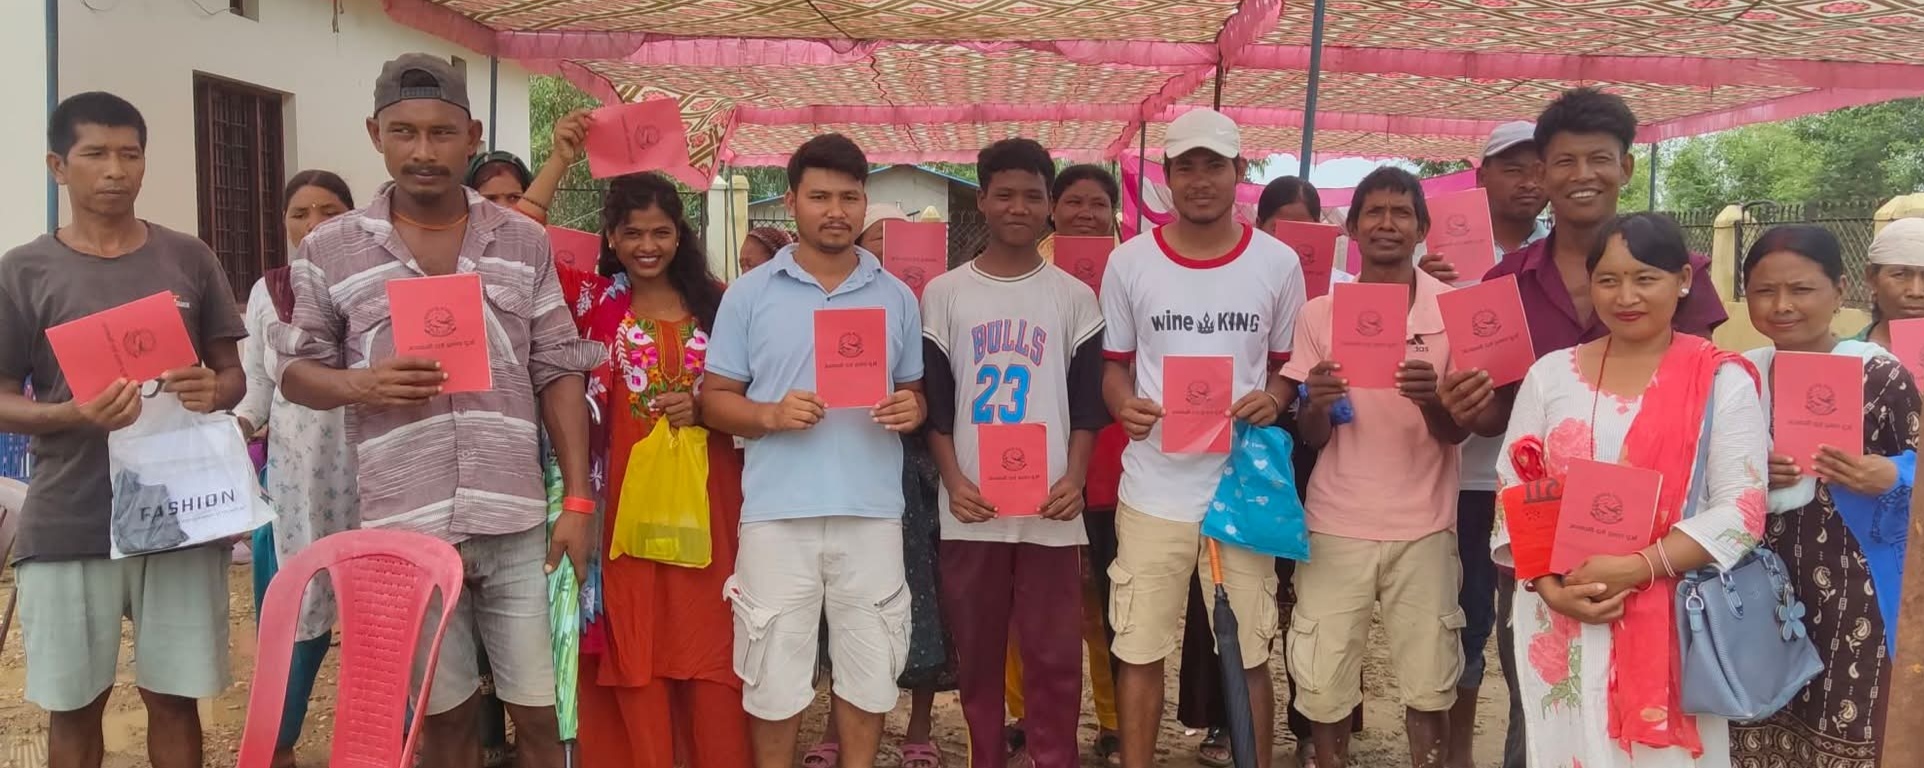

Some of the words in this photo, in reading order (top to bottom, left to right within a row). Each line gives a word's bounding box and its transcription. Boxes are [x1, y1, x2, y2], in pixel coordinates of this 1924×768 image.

[1151, 309, 1194, 332] wine
[1217, 311, 1260, 333] KING
[971, 318, 1047, 367] BULLS
[971, 363, 1031, 424] 23
[140, 489, 235, 521] FASHION
